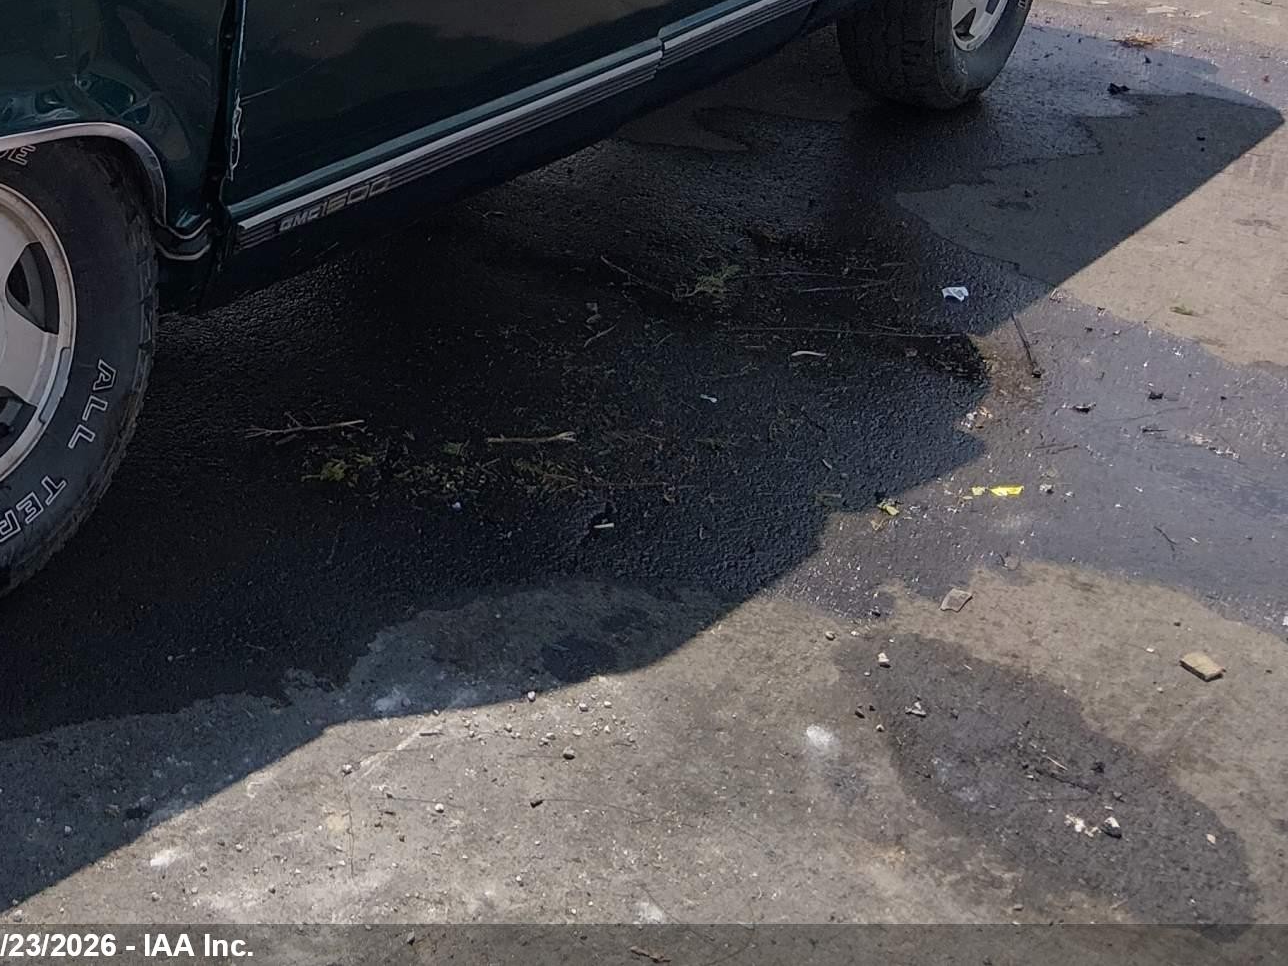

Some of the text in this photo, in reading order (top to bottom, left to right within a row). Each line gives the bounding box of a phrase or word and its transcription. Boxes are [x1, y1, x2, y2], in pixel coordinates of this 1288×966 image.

[279, 175, 391, 232] GMC 1500
[68, 359, 116, 449] ALL
